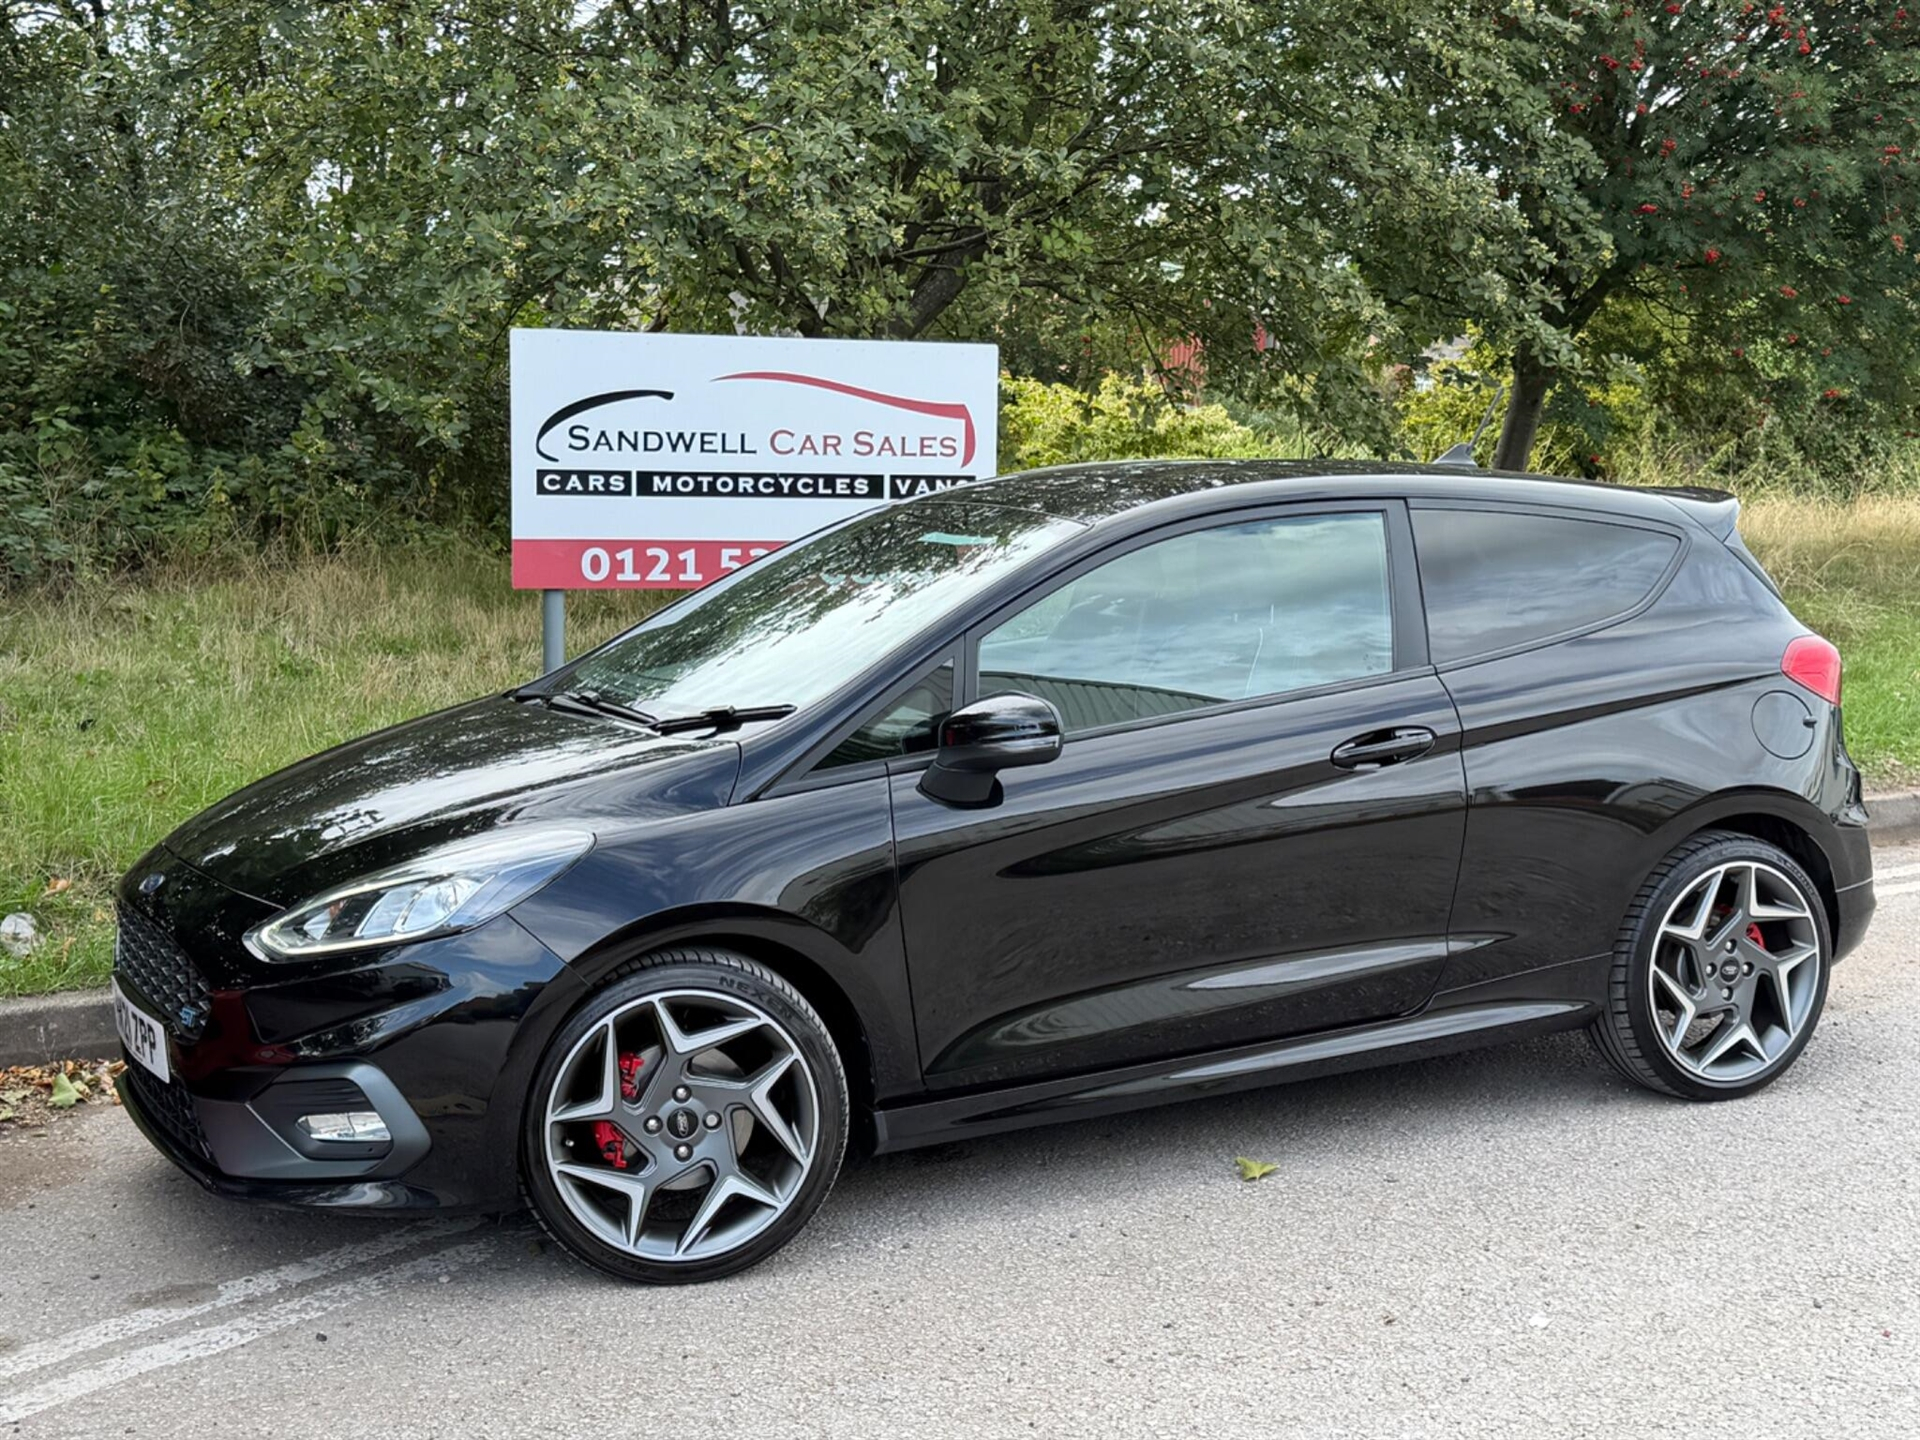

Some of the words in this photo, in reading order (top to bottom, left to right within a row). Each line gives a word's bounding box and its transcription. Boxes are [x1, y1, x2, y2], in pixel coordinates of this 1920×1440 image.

[568, 424, 757, 455] SANDWELL
[769, 429, 842, 457] CAR
[853, 430, 957, 458] SALES
[542, 474, 626, 492] CARS
[652, 475, 869, 495] MOTORCYCLES
[581, 547, 704, 582] 0121
